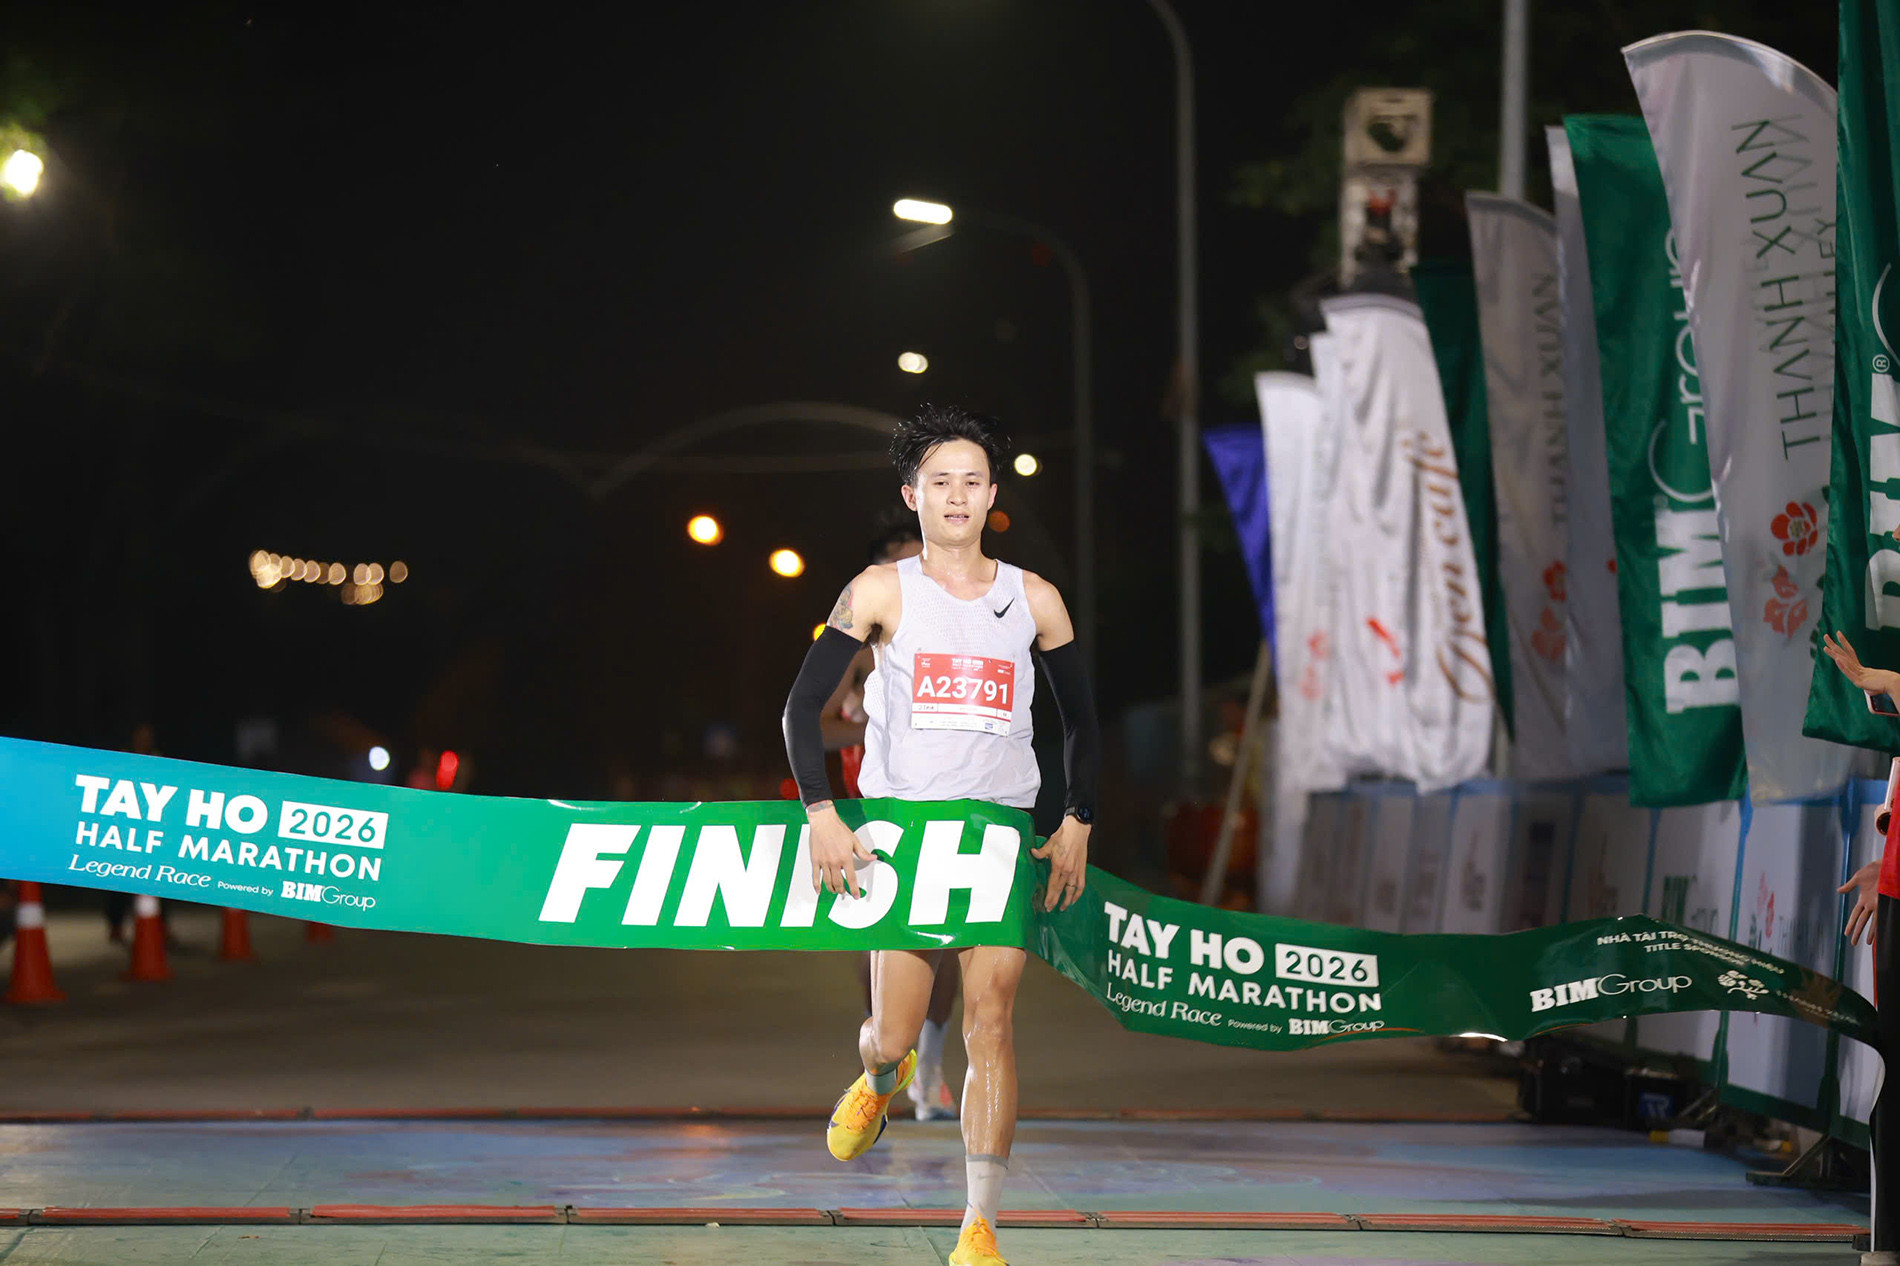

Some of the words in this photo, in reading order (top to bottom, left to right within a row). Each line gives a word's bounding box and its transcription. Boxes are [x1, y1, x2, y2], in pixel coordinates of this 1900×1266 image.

[916, 675, 1008, 705] A23791
[75, 774, 178, 822] TAY
[185, 789, 268, 834] HO
[289, 808, 376, 842] 2026
[68, 853, 151, 881] Legend
[155, 866, 212, 888] Race
[217, 881, 260, 895] Powered
[261, 885, 274, 897] by
[75, 821, 164, 854] HALF
[178, 836, 382, 882] MARATHON
[538, 820, 1022, 929] FINISH
[1104, 901, 1181, 959] TAY
[1190, 928, 1265, 975] HO
[1285, 950, 1368, 982] 2026
[1643, 942, 1682, 953] TITLE
[1106, 982, 1167, 1018] Legend
[1170, 1001, 1223, 1027] Race
[1227, 1018, 1269, 1033] Powered
[1269, 1024, 1283, 1035] by
[1107, 949, 1173, 990] HALF
[1188, 972, 1382, 1014] MARATHON
